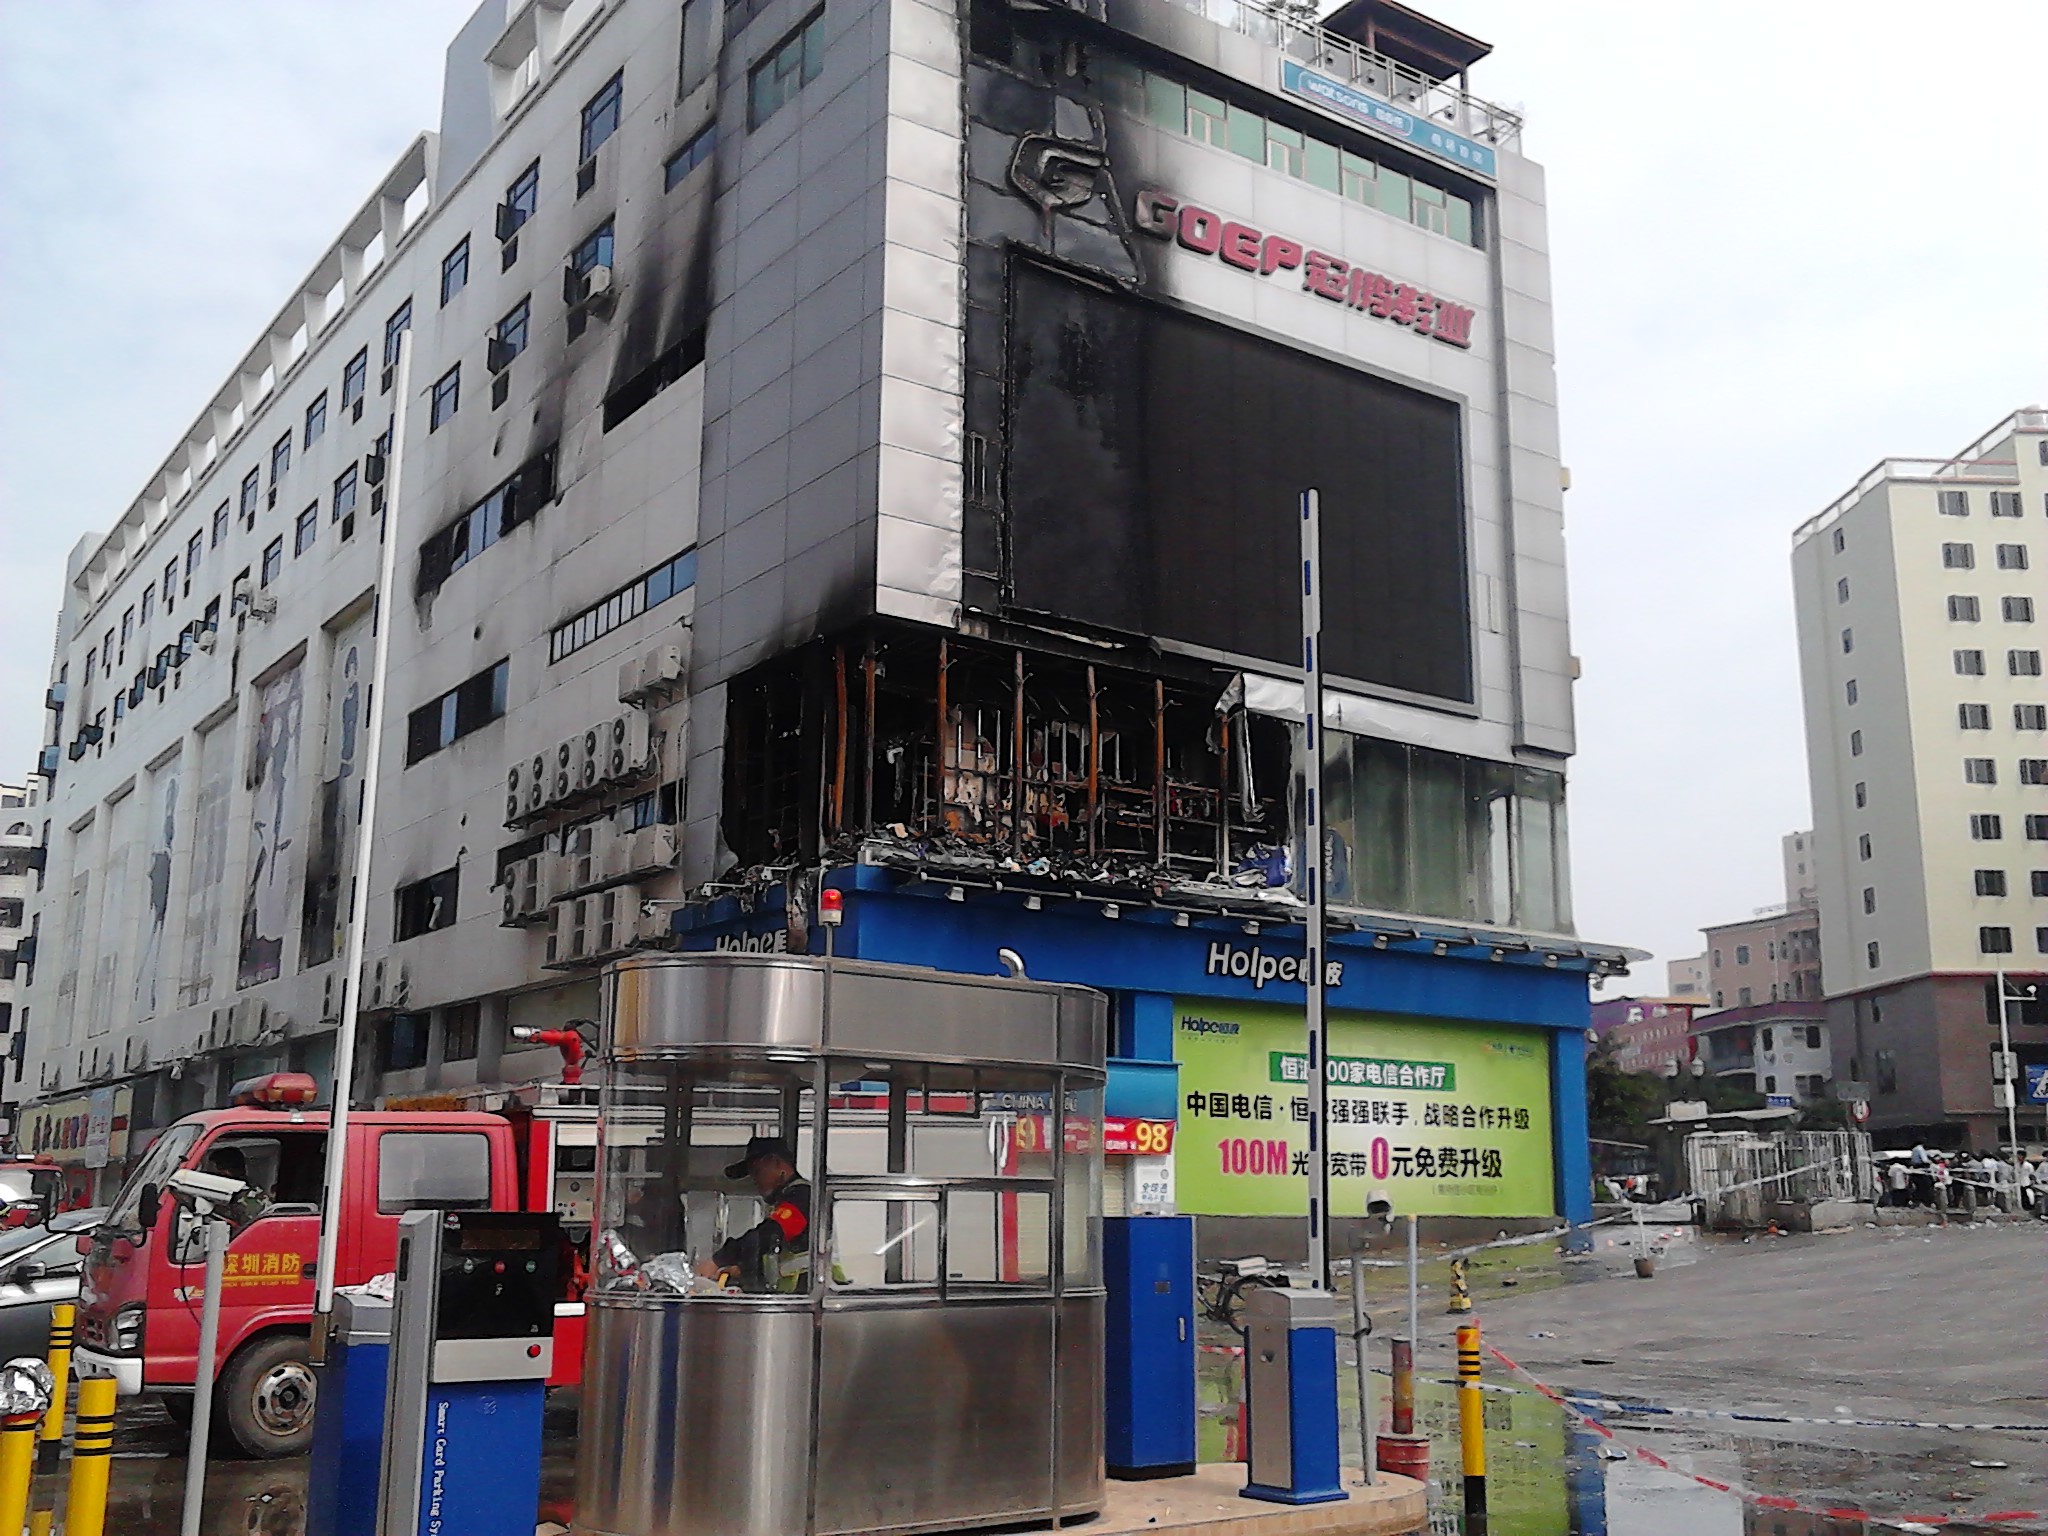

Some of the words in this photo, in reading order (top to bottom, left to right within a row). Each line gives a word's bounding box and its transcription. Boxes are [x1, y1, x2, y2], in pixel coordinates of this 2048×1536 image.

[1134, 189, 1304, 276] GOEP
[1207, 942, 1298, 989] Holpe
[1280, 1055, 1446, 1089] 恒00家电信合作厅
[1136, 1122, 1168, 1152] 98
[222, 1252, 301, 1275] 深圳消防
[437, 1402, 449, 1435] Smart
[434, 1438, 447, 1466] Card
[430, 1469, 445, 1517] Parking
